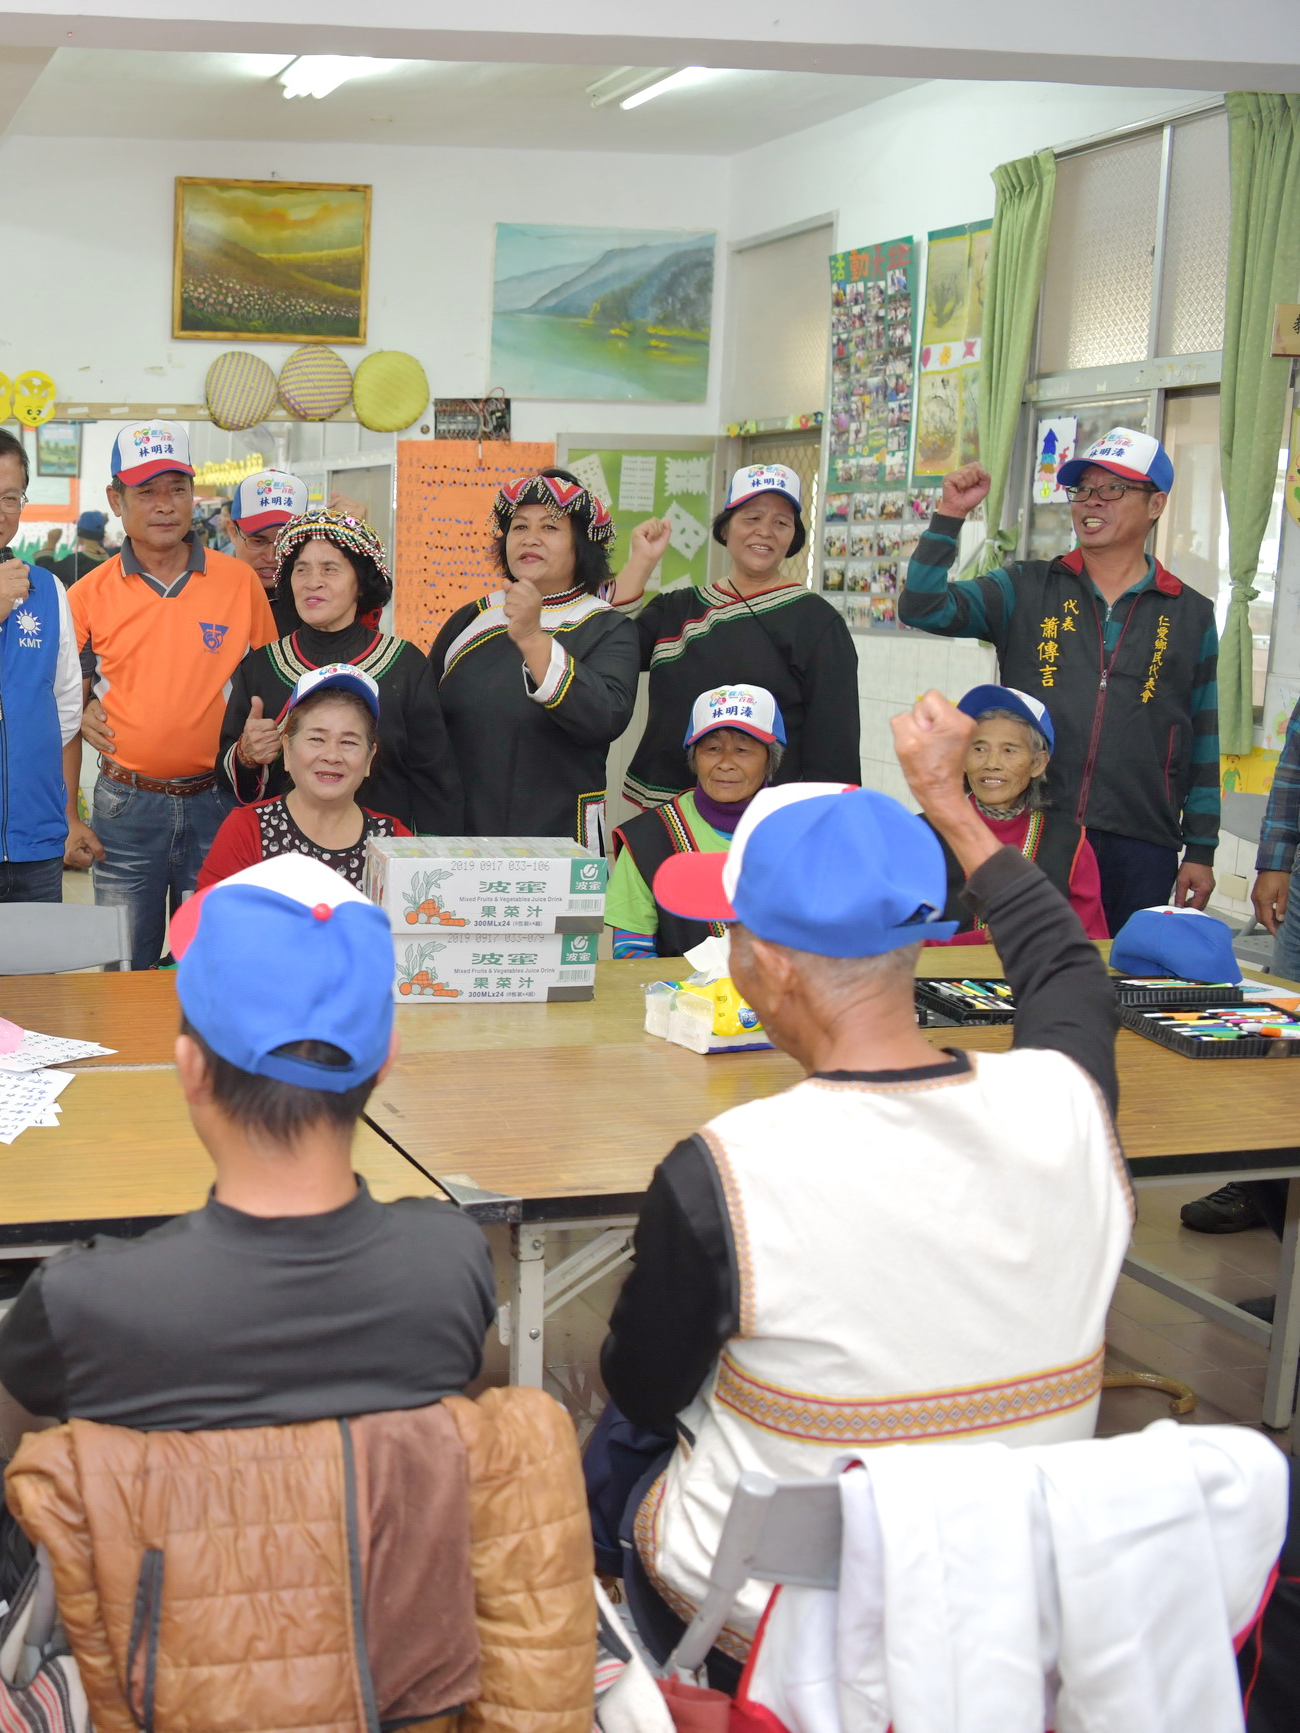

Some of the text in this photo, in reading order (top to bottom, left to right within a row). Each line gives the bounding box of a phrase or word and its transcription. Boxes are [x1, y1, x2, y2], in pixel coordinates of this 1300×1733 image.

[1061, 599, 1079, 632] 代表
[19, 638, 42, 648] KMT
[1037, 616, 1060, 687] 蕭傳言
[1140, 615, 1170, 703] 仁愛鄉民代表會
[451, 860, 550, 871] 2019 0917 033-106
[479, 880, 547, 894] 波蜜
[575, 881, 601, 891] 波蜜
[480, 905, 543, 918] 果菜汁
[447, 933, 545, 943] 2019 0917 033-079
[471, 953, 539, 965] 波蜜
[566, 952, 591, 962] 波蜜
[473, 976, 534, 988] 果菜汁
